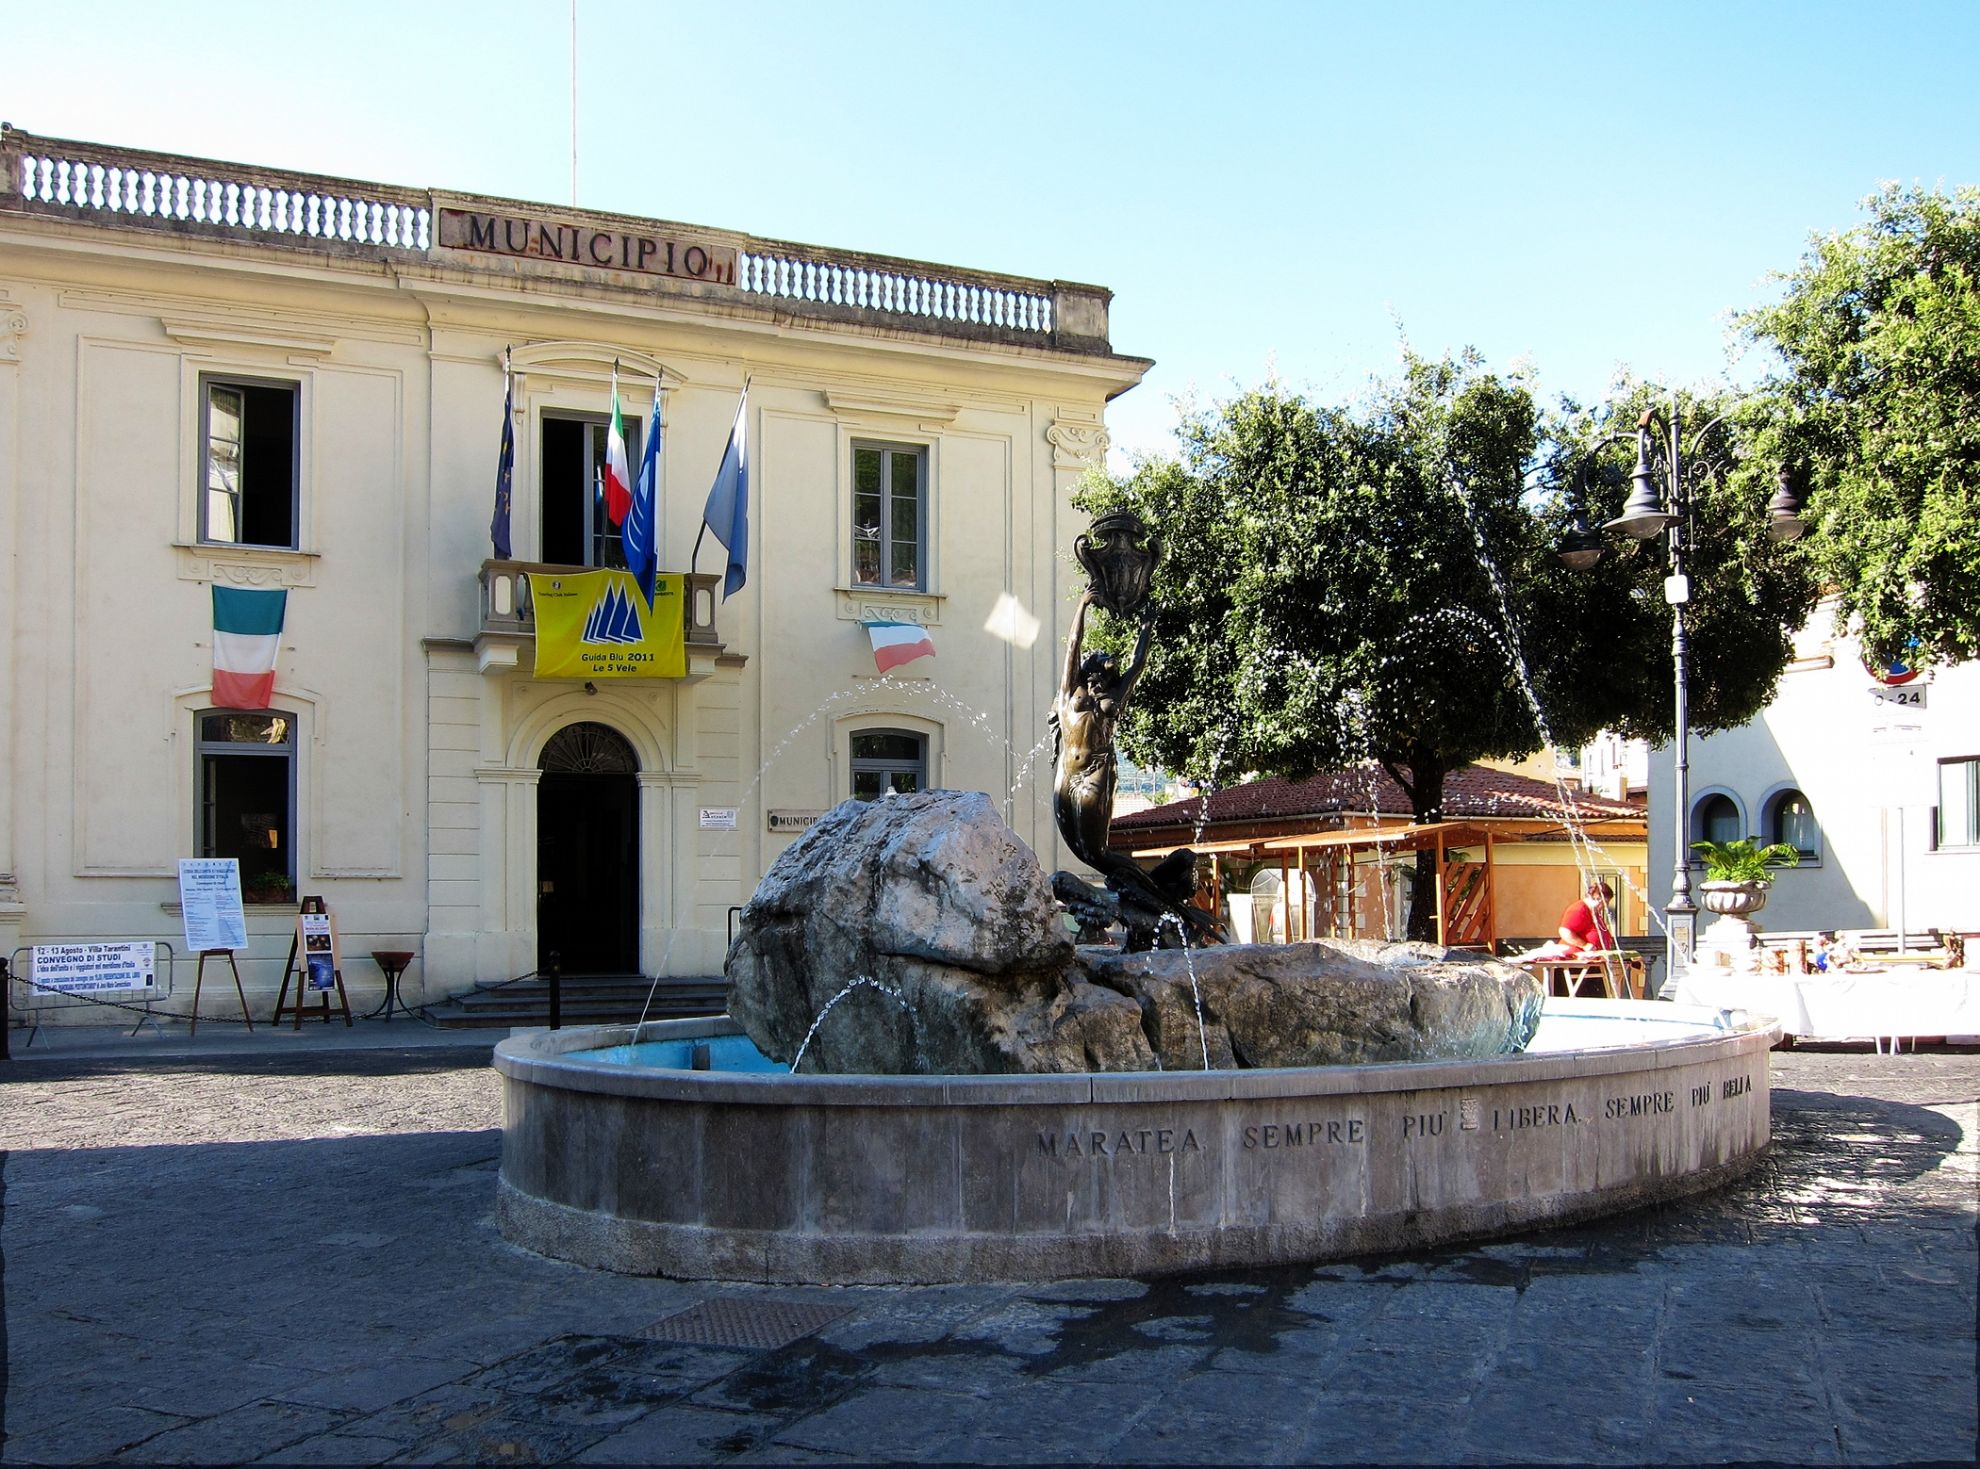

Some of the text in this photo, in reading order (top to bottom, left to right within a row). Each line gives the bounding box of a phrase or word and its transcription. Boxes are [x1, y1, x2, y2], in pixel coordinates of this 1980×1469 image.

[469, 215, 708, 276] MUNICIPIO
[581, 653, 655, 662] Guida Blu 2011
[593, 664, 604, 672] Le
[616, 664, 637, 672] Vele
[1898, 692, 1920, 705] 24
[37, 946, 45, 955] 12
[51, 946, 59, 955] 13
[60, 945, 83, 956] Agosto
[88, 944, 102, 953] Villa
[104, 944, 131, 952] Tarantini
[37, 955, 84, 964] CONVEGNO
[97, 953, 121, 961] STUDI
[1243, 1120, 1364, 1149] SEMPRE
[1605, 1092, 1674, 1120] SEMPRE
